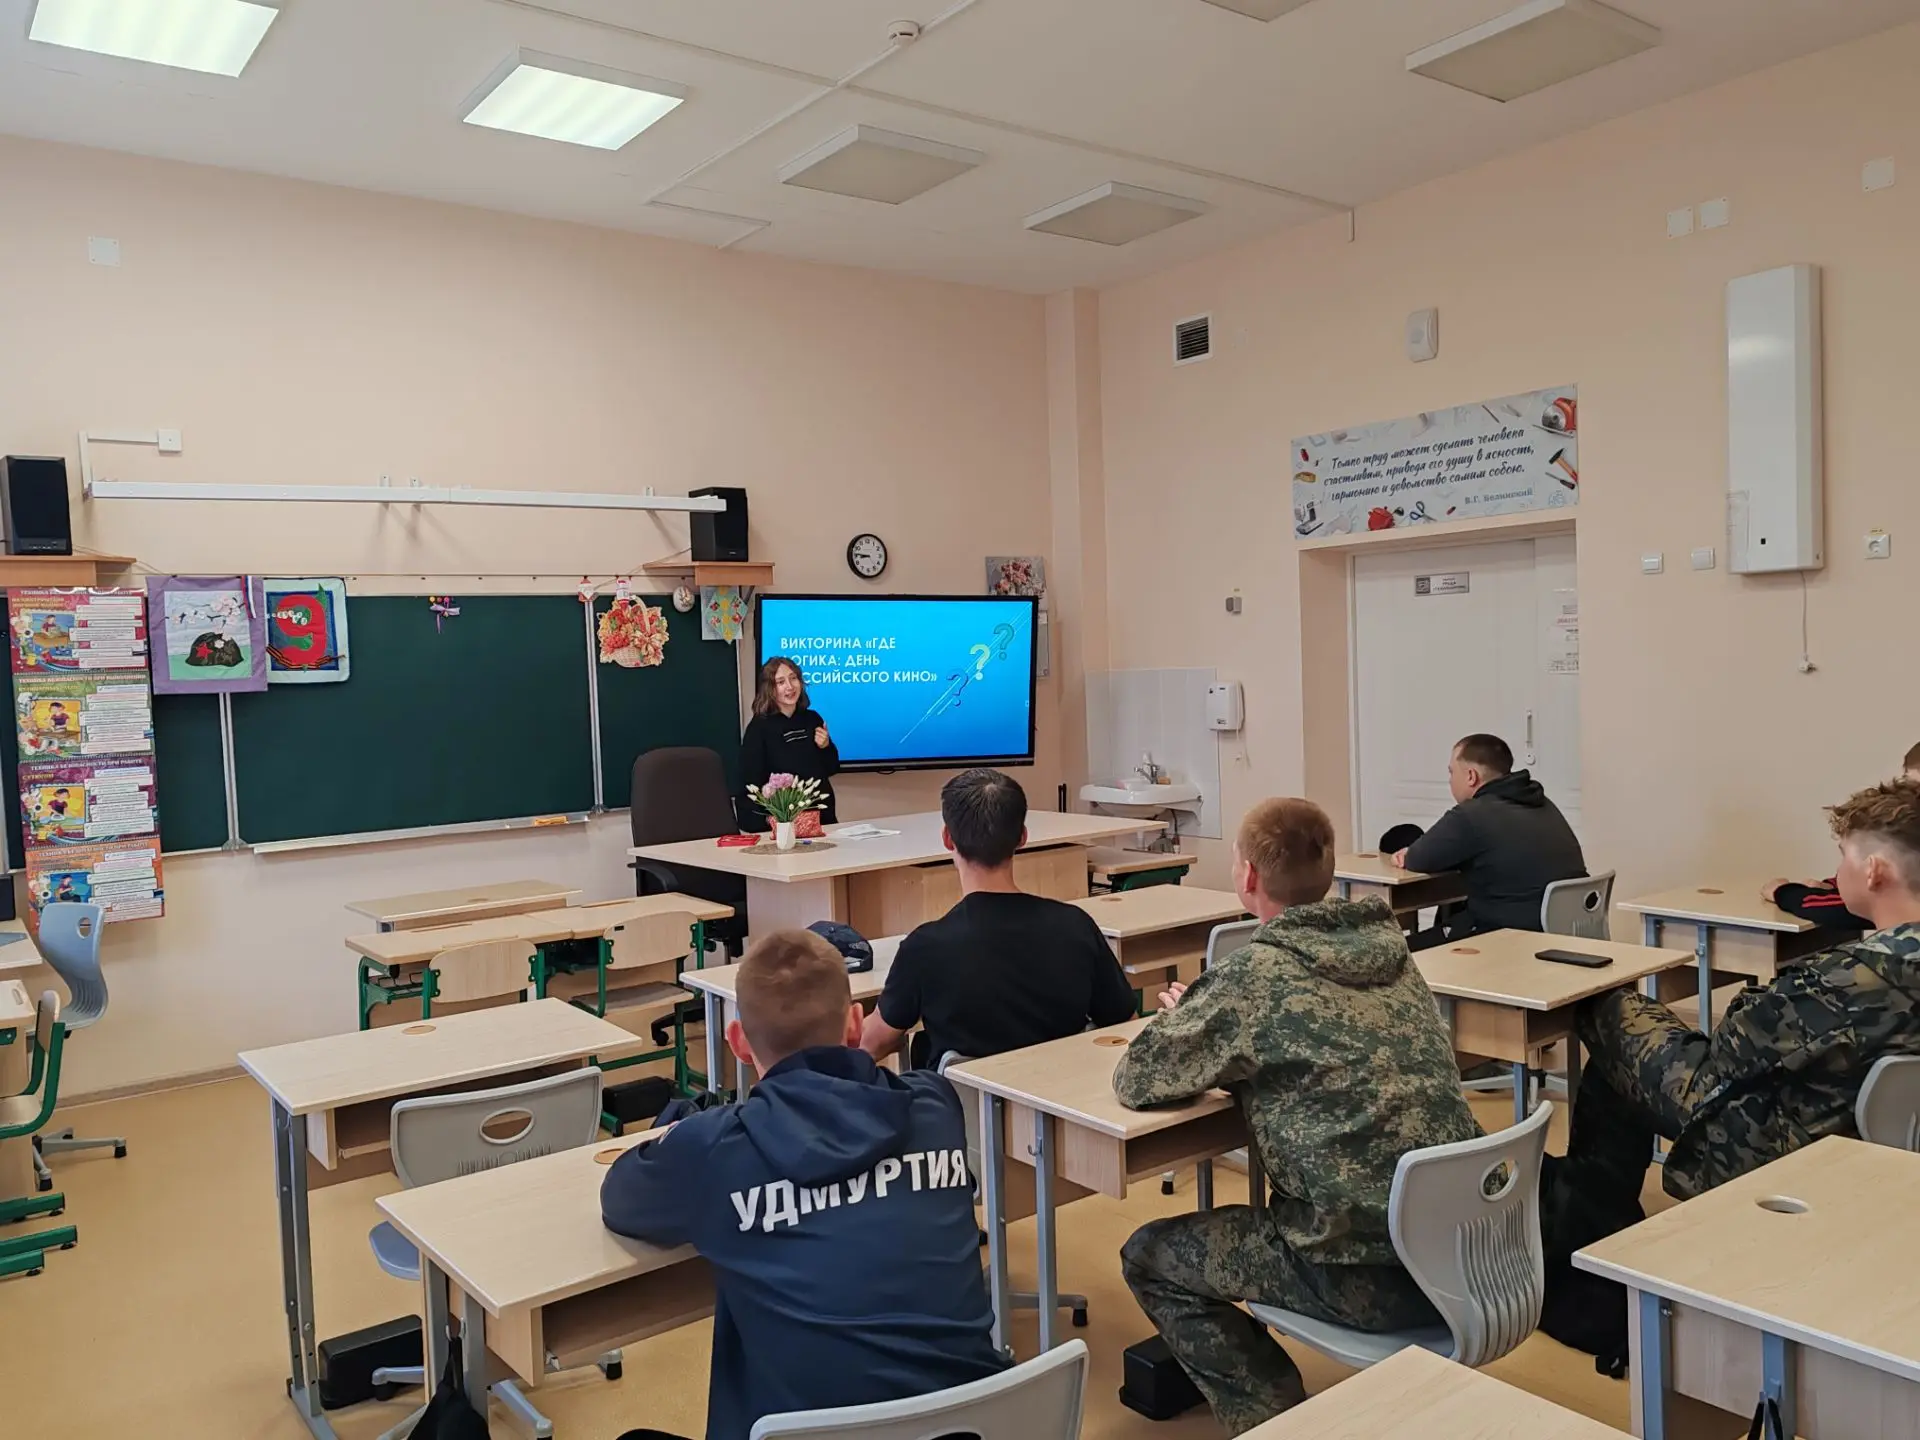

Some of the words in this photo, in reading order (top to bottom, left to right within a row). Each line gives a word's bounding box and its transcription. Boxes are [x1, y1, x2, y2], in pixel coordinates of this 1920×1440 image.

[1324, 468, 1383, 487] счастливым,
[1386, 460, 1427, 479] приводя
[1428, 459, 1443, 470] его
[1446, 454, 1474, 472] душу
[1477, 448, 1483, 461] в
[1485, 444, 1535, 460] ясность,
[1363, 452, 1389, 467] труд
[1391, 445, 1430, 459] может
[1432, 438, 1474, 456] сделать
[1478, 426, 1525, 444] человека
[1332, 486, 1380, 503] гармонию
[1382, 485, 1388, 493] и
[1389, 472, 1448, 497] довольство
[1449, 470, 1486, 483] самим
[1489, 461, 1525, 477] собою.
[780, 637, 862, 649] ВИКТОРИНА
[865, 637, 896, 650] «ГДЕ
[784, 654, 841, 666] ОГИКА:
[844, 655, 880, 668] ДЕНЬ
[802, 669, 889, 684] ССИЙСКОГО
[893, 671, 938, 683] КИНО»
[730, 1149, 967, 1232] УДМУРТИЯ
